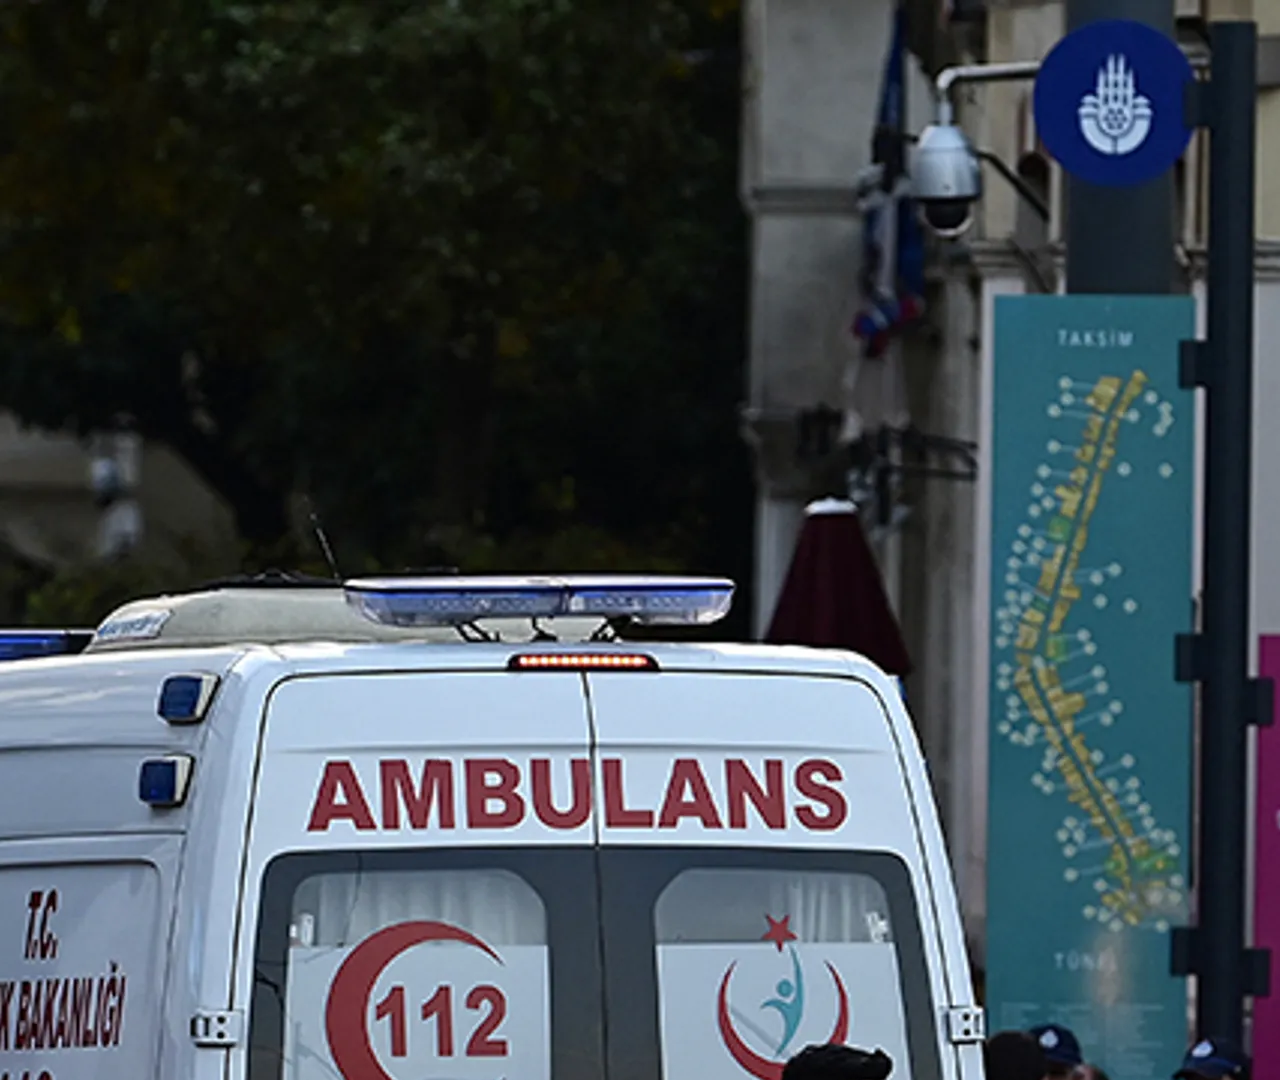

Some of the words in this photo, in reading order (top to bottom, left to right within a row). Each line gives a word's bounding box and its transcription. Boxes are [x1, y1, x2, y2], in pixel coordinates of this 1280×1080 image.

[1057, 328, 1134, 348] TAKSİM
[307, 757, 848, 832] AMBULANS
[15, 960, 126, 1050] BAKANLIĞI
[374, 985, 508, 1058] 112
